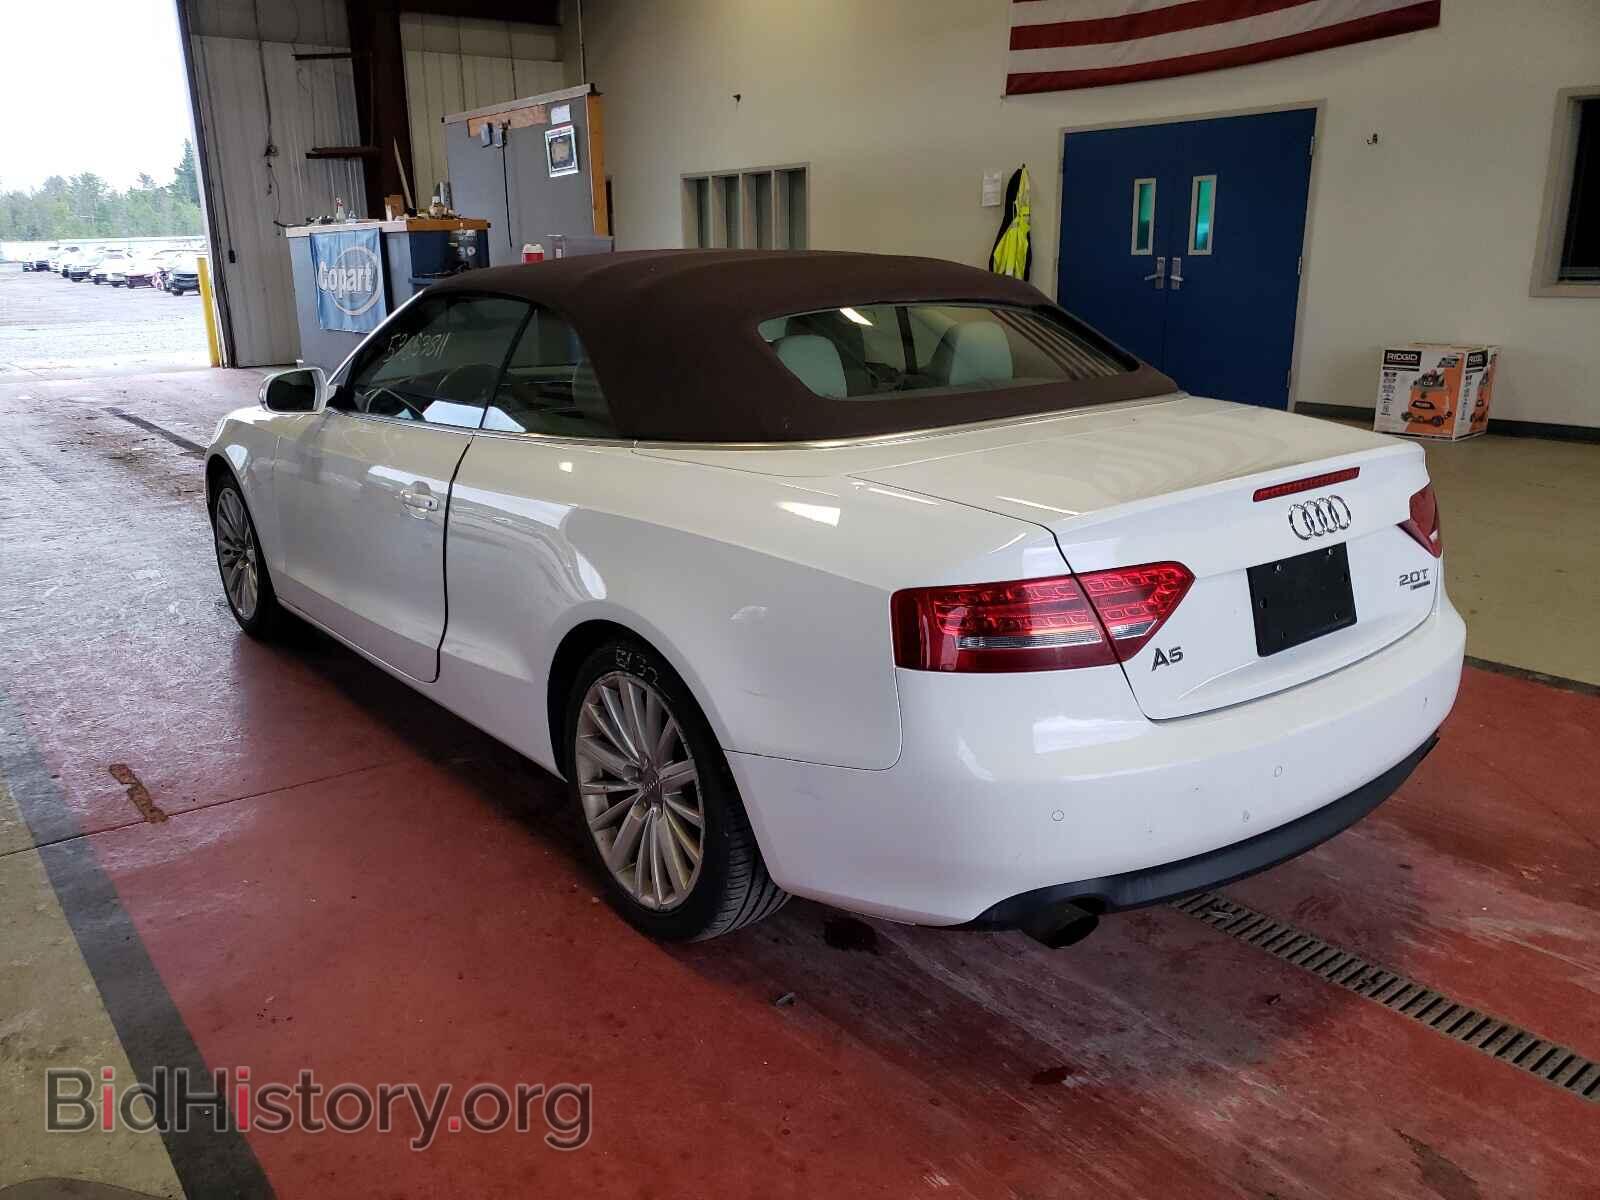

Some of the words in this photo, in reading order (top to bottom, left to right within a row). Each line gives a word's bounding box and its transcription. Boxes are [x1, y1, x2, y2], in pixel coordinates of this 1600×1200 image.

[318, 261, 373, 299] Copart
[1387, 352, 1418, 361] RIDGID
[1151, 646, 1183, 672] A5
